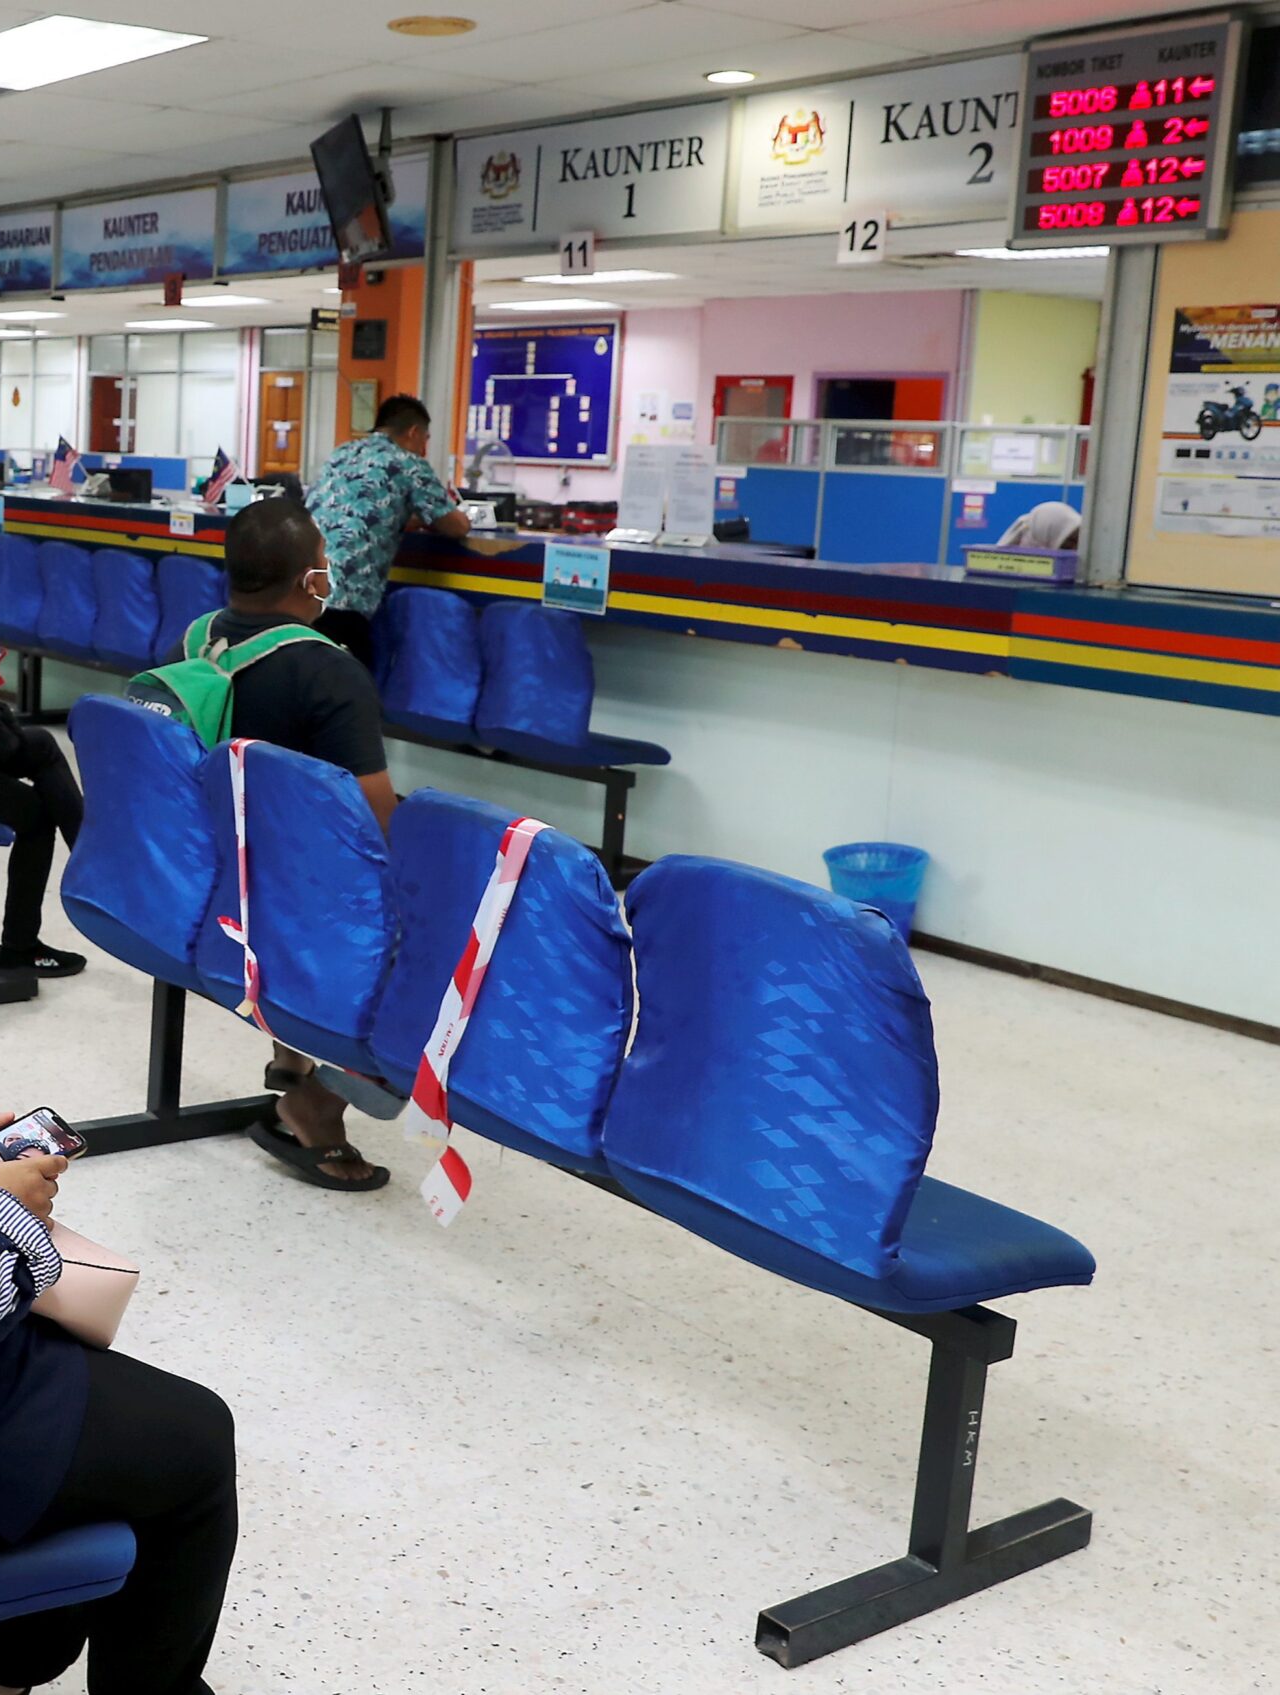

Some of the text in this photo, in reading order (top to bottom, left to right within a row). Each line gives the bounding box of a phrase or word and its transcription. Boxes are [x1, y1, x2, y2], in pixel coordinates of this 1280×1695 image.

[1036, 41, 1218, 79] NOMBOR TIKET KAUNTER
[1049, 76, 1186, 119] 5006 11
[1049, 117, 1184, 155] 1009 2
[559, 135, 705, 183] KAUNTER
[966, 141, 995, 186] 2
[1042, 157, 1179, 193] 5007 12
[622, 182, 636, 219] 1
[1038, 196, 1174, 230] 5008 12
[103, 211, 159, 240] KAUNTER
[845, 220, 880, 252] 12
[563, 240, 588, 269] 11
